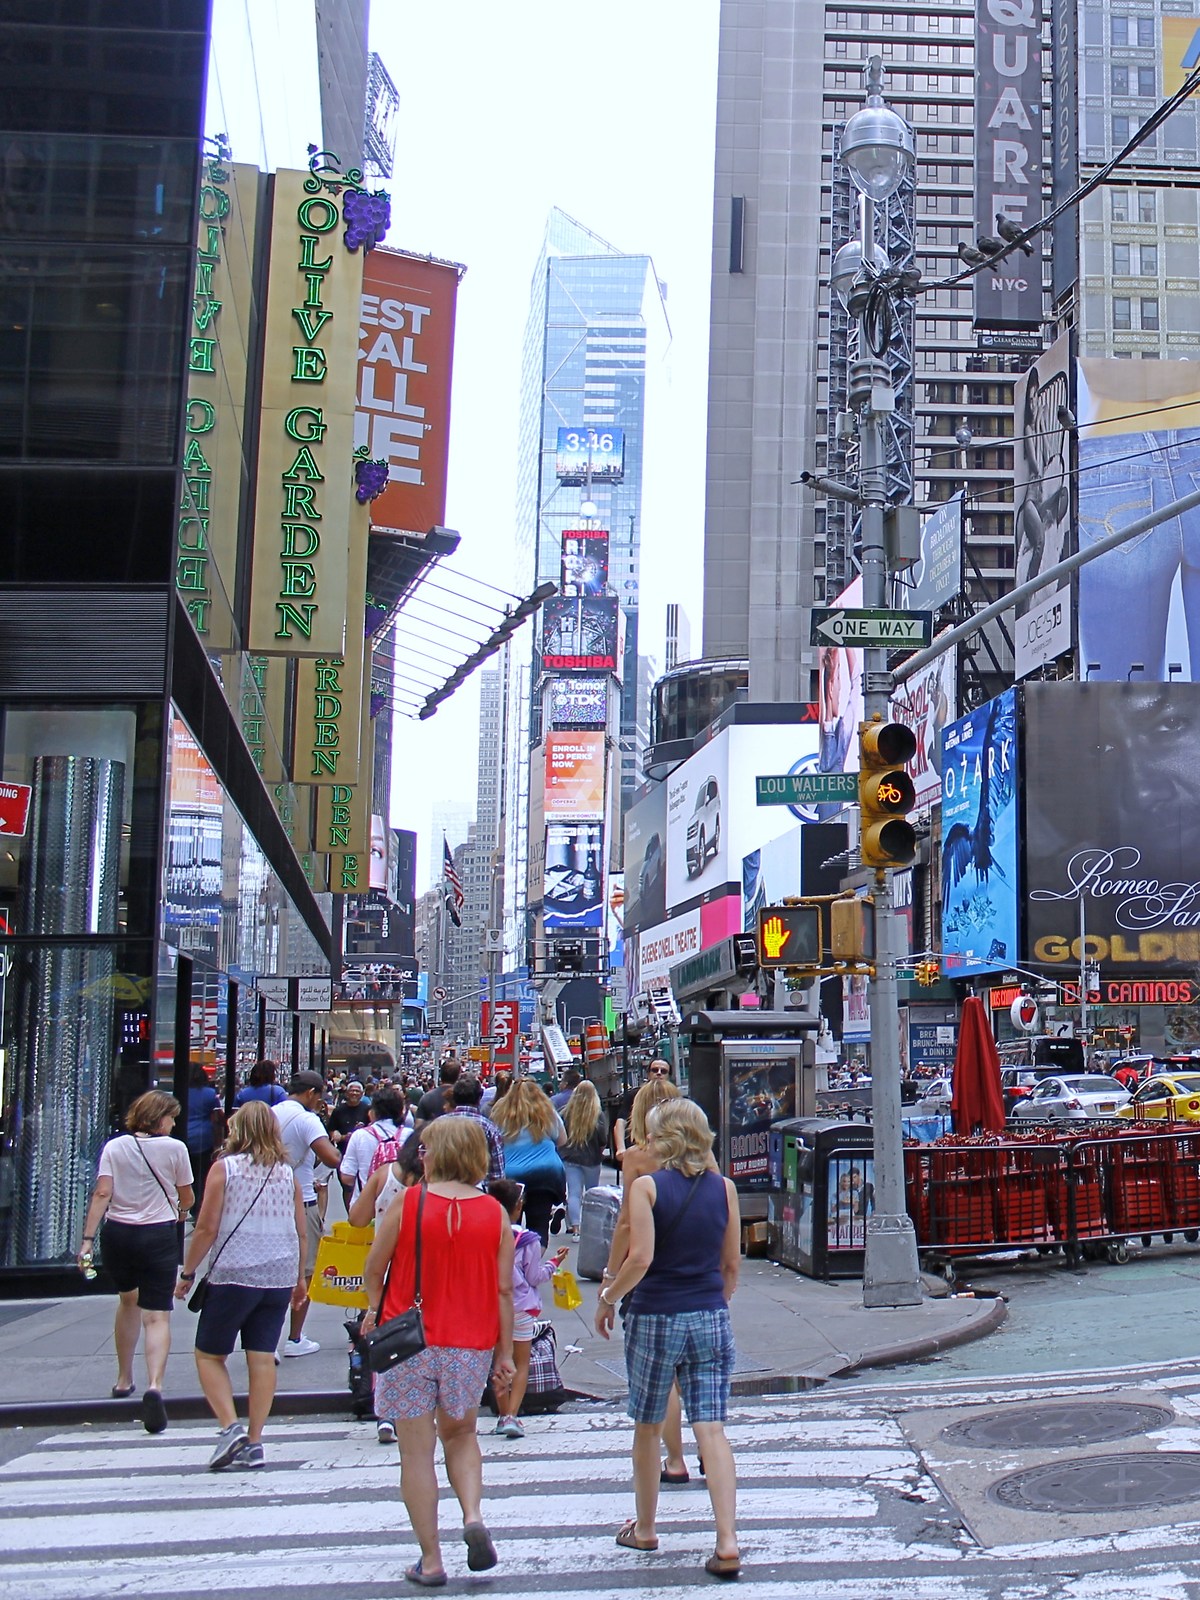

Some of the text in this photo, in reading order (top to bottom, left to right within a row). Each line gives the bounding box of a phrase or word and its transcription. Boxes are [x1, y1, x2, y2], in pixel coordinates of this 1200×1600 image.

[292, 197, 339, 382] OLIVE
[991, 278, 1028, 292] NYC
[275, 406, 328, 638] GARDEN
[562, 532, 609, 540] TOSHIBA
[833, 621, 915, 636] ONE WAY
[542, 656, 615, 667] TOSHIBA
[566, 694, 602, 705] TDK
[311, 657, 344, 775] RDEN
[945, 738, 1010, 798] OZARK
[759, 776, 855, 793] LOU WALTERS
[797, 793, 816, 801] WAY
[577, 827, 600, 835] DIVE
[549, 836, 570, 845] BAR
[574, 843, 601, 851] TOUR
[1029, 846, 1160, 900] Romeo
[1108, 982, 1191, 1003] CAMINOS
[929, 1048, 953, 1056] DINNER
